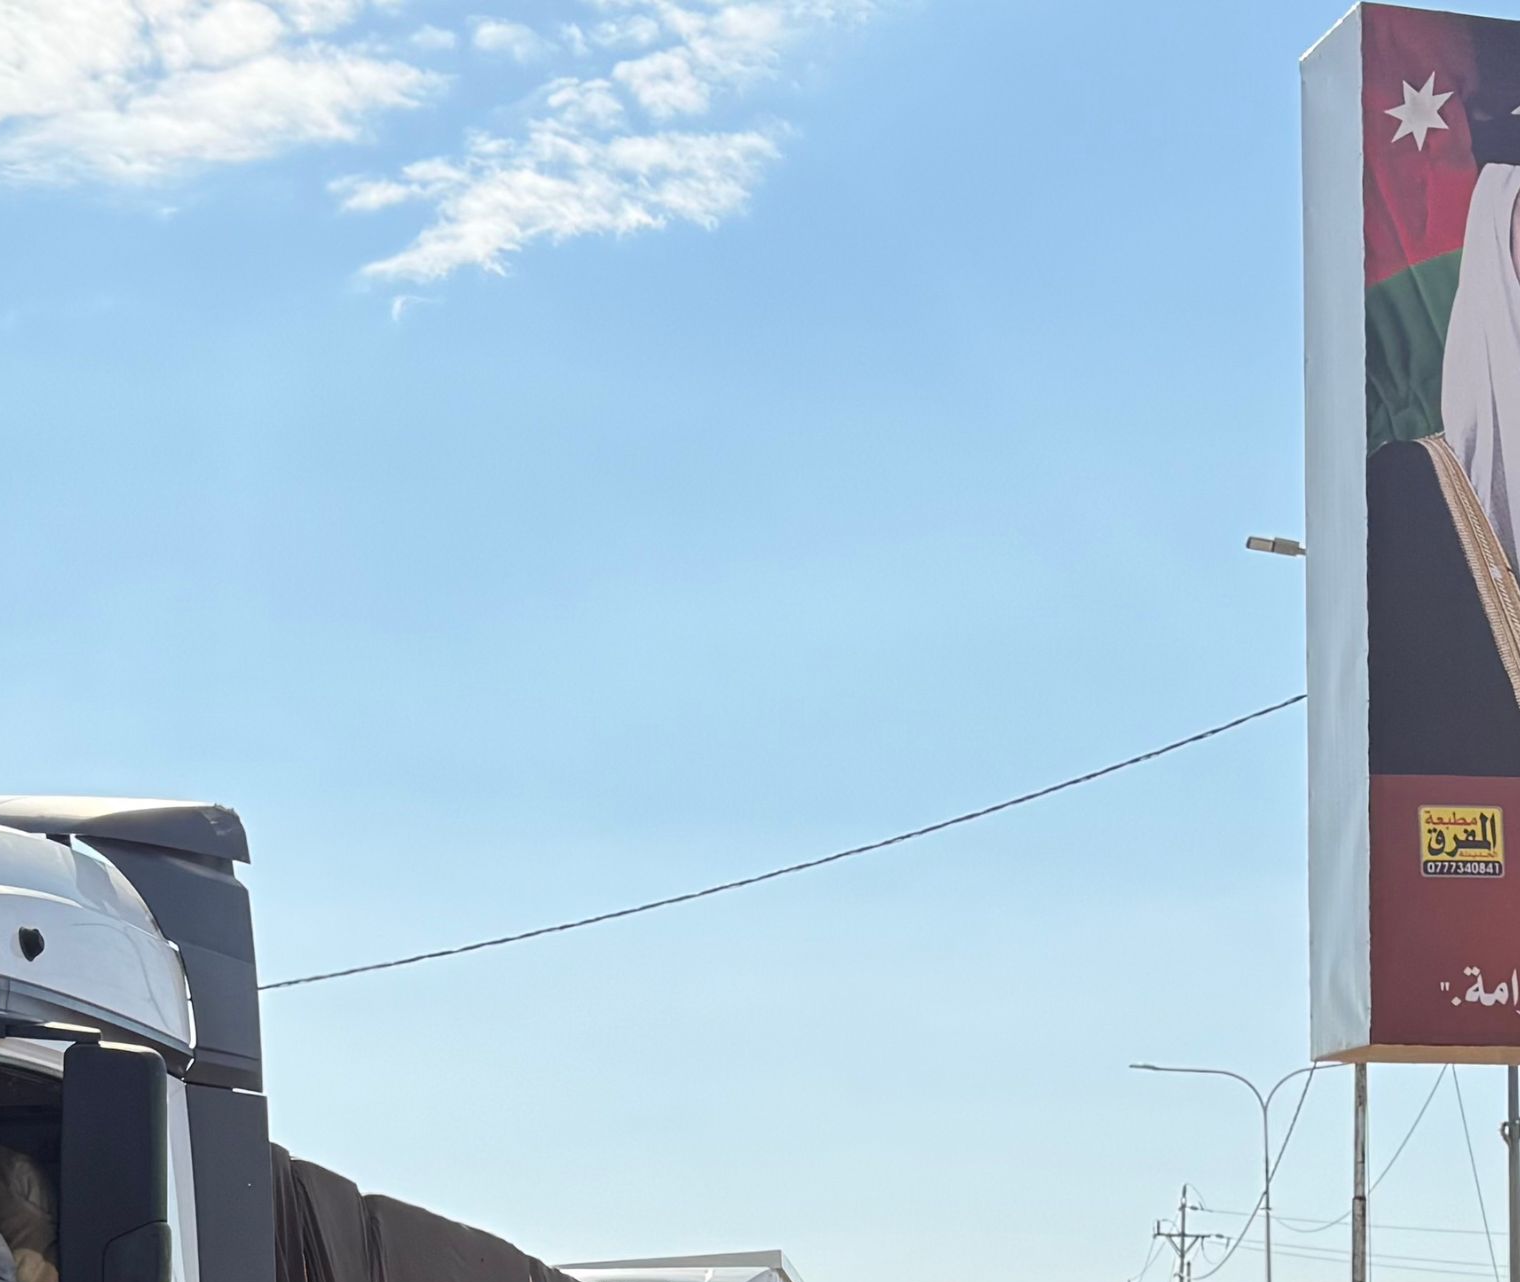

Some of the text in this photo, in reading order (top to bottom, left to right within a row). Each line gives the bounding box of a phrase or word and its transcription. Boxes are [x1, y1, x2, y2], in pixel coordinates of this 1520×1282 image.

[1424, 810, 1478, 829] مطبعة
[1427, 812, 1497, 858] المفرق
[1427, 862, 1500, 874] 0777340841
